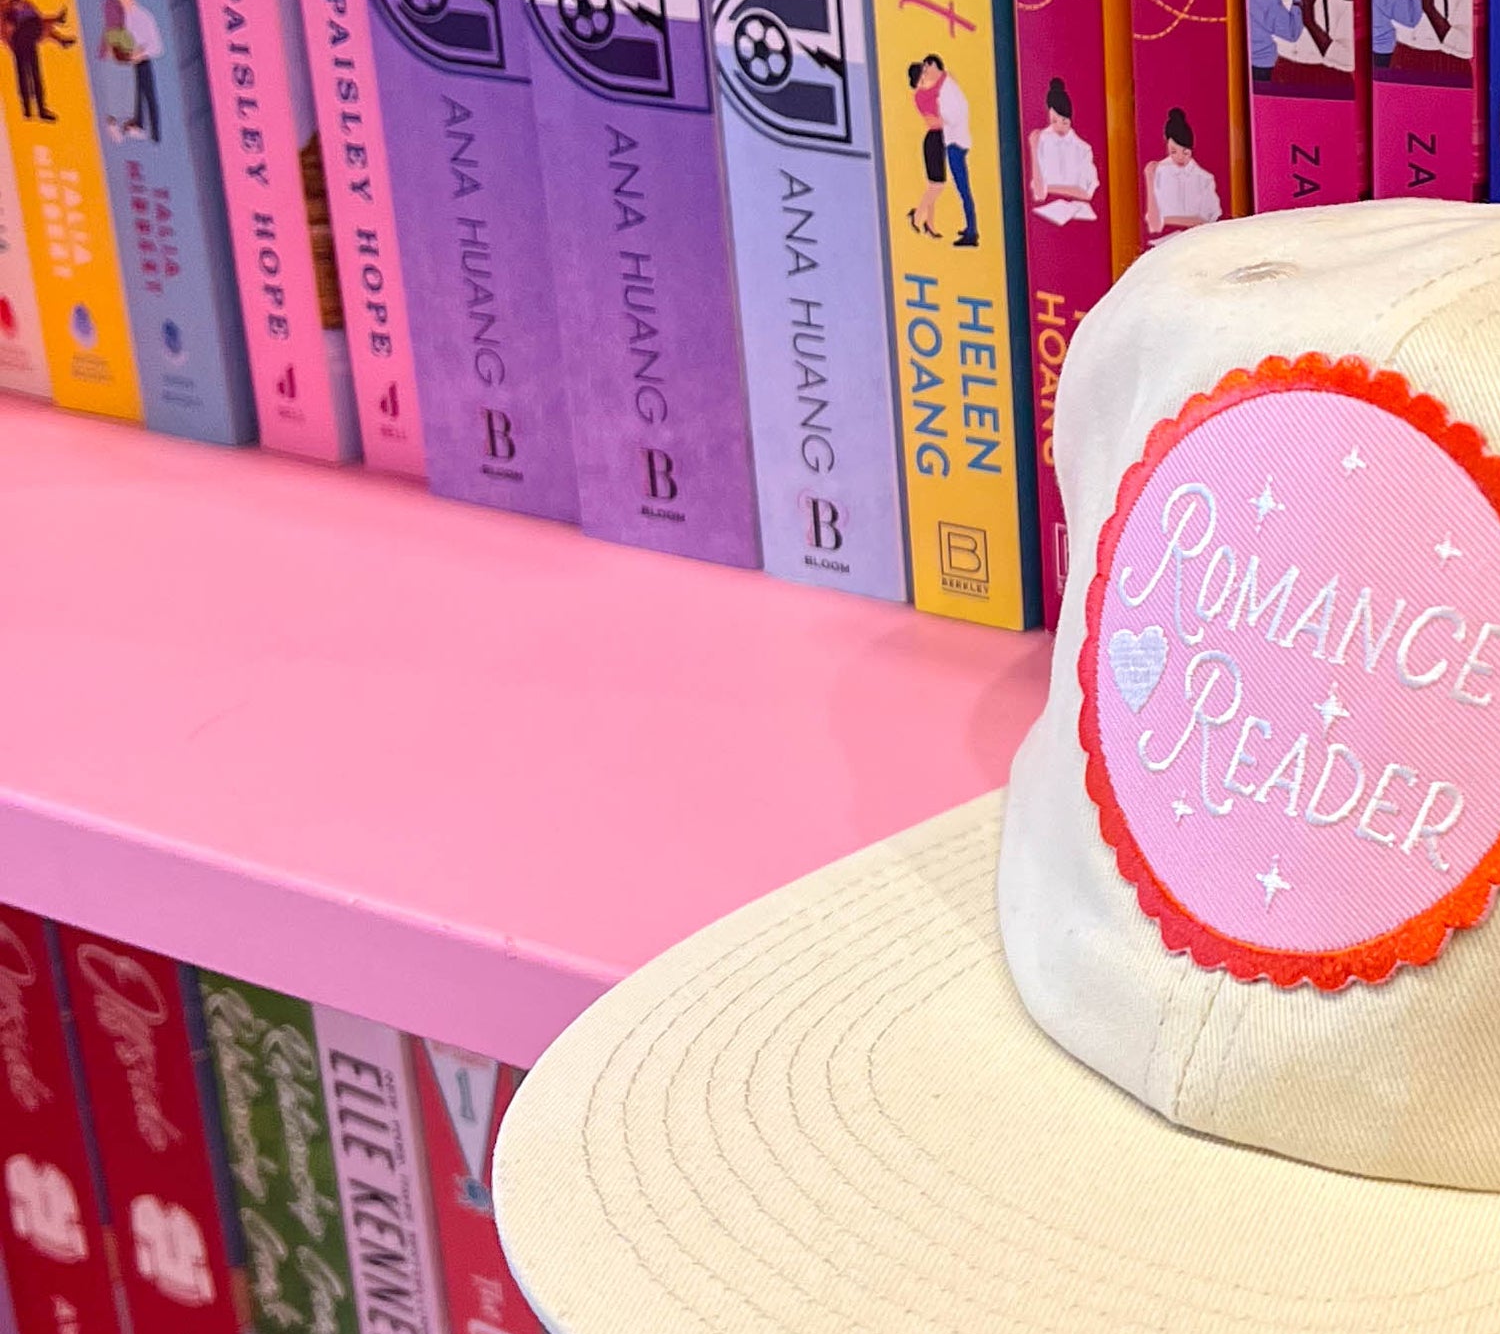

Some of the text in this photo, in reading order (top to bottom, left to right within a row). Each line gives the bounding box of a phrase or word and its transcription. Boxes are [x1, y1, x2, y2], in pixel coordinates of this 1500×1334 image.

[252, 211, 291, 341] HOPE
[354, 225, 393, 359] HOPE
[441, 94, 507, 389] ANA HUANG
[604, 123, 668, 427] ANA HUANG
[779, 168, 835, 476] ANA HUANG
[904, 273, 951, 479] HOANG
[956, 295, 1002, 475] HELEN
[330, 1048, 397, 1170] ELLE
